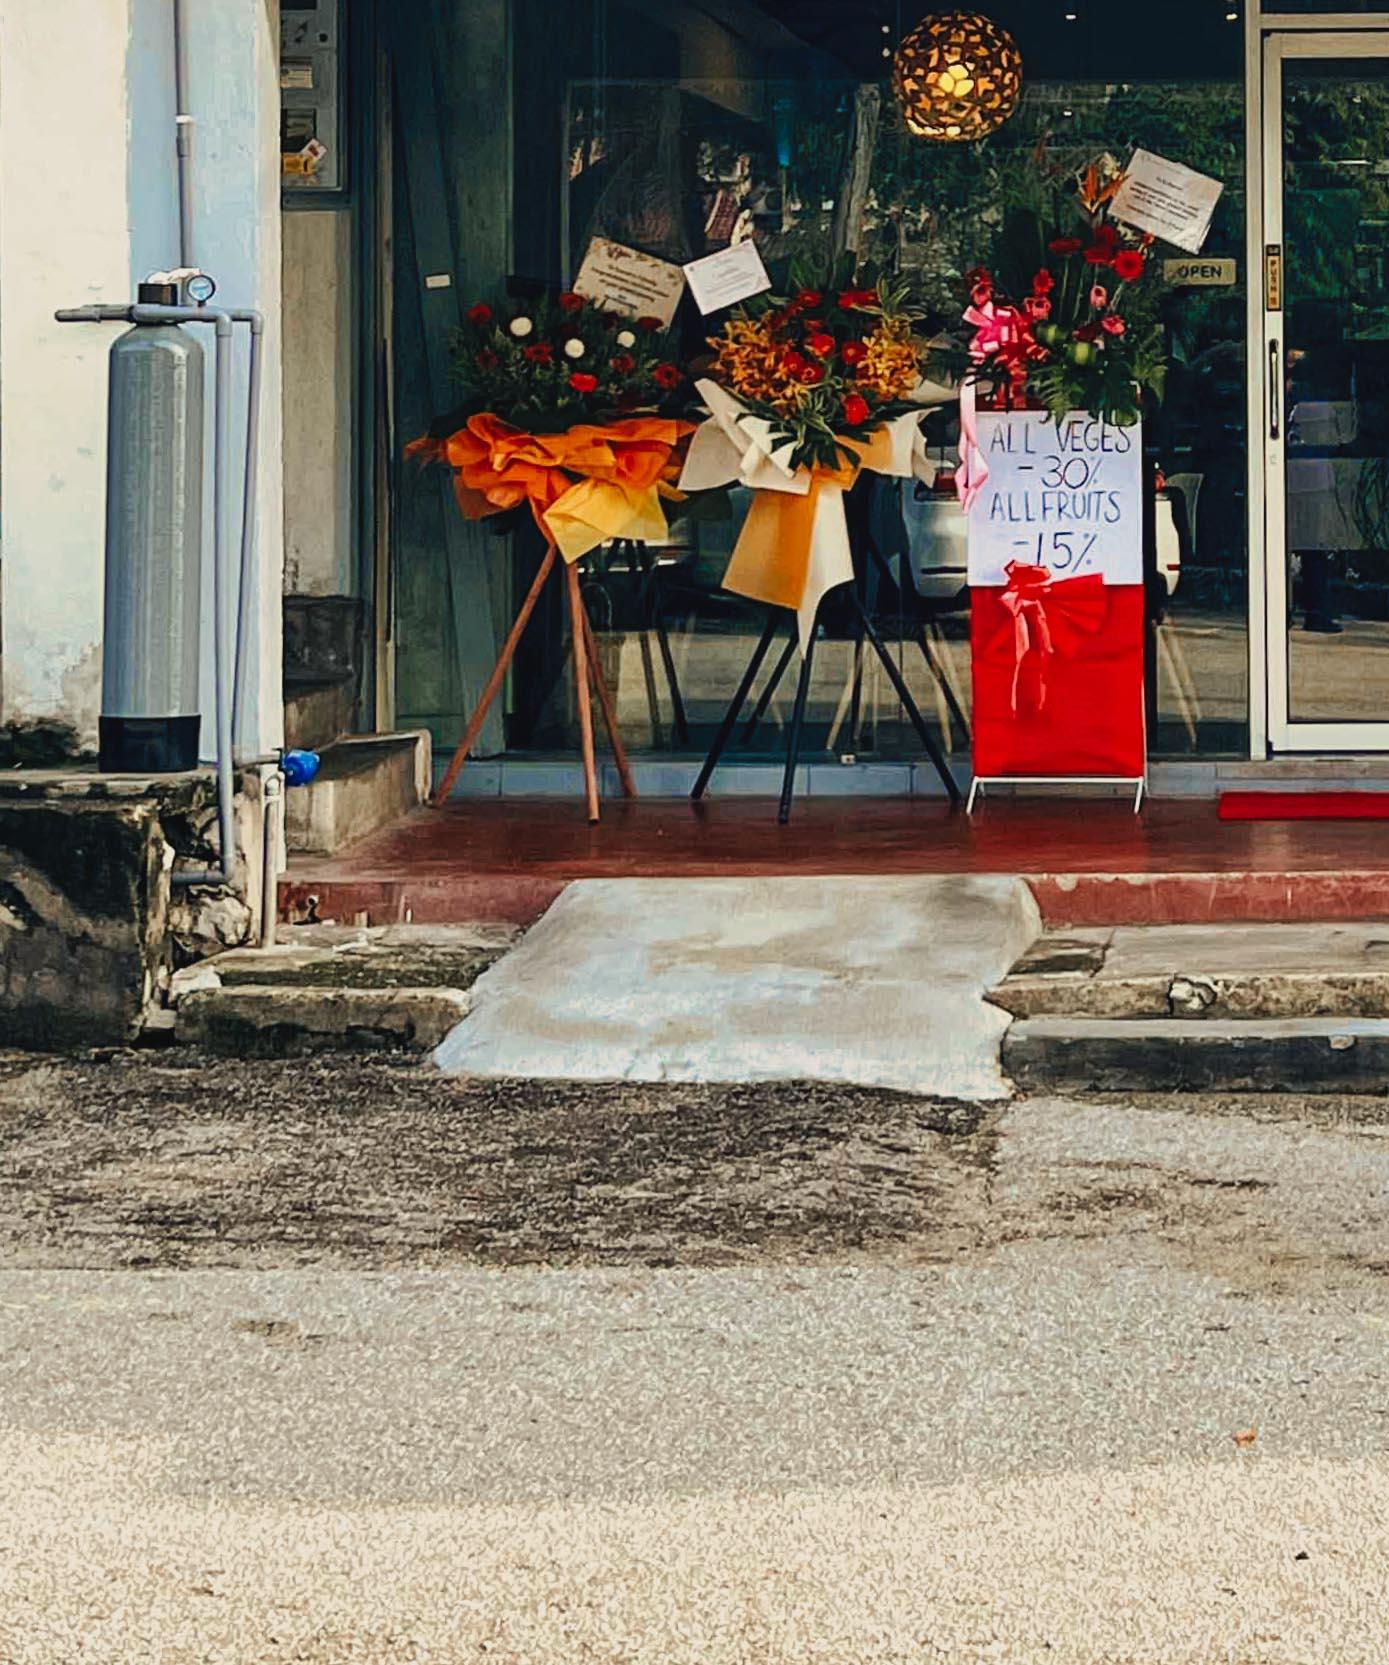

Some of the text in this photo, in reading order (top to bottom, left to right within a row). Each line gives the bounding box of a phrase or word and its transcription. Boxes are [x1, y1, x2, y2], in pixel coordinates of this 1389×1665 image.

[1178, 265, 1222, 279] OPEN
[989, 419, 1132, 455] ALL VEGES
